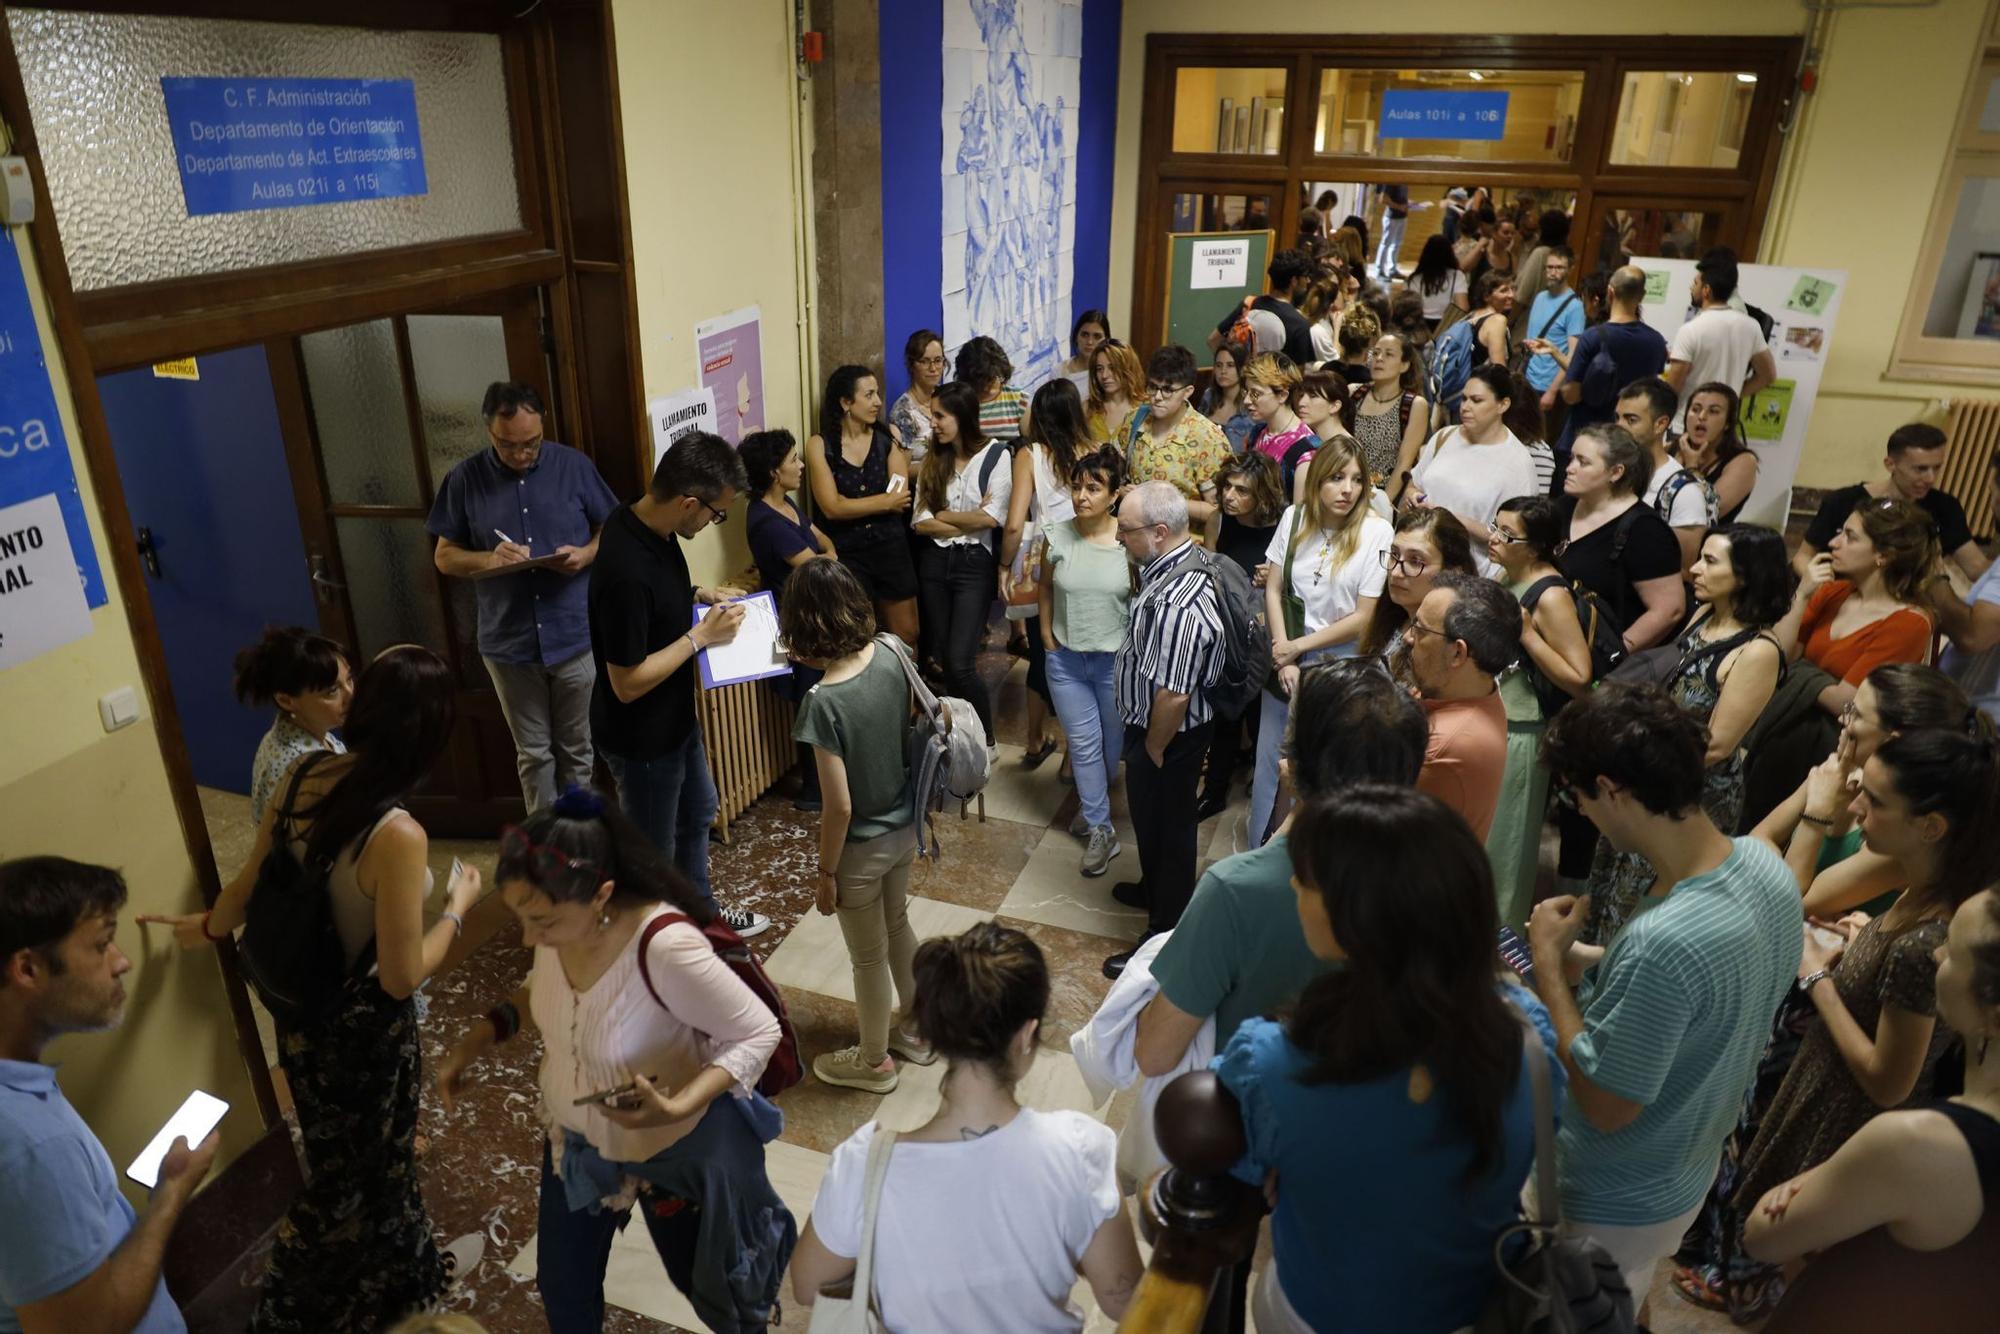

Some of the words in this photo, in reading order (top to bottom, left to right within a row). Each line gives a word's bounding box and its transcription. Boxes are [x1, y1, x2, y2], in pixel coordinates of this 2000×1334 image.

[224, 88, 241, 107] C.
[246, 88, 261, 106] F.
[267, 87, 371, 106] Administración
[1387, 108, 1421, 120] Aulas
[1458, 112, 1466, 121] a
[191, 119, 303, 143] Departamento
[307, 118, 325, 136] de
[329, 116, 404, 136] Orientación
[185, 151, 284, 175] Departamento
[287, 150, 304, 167] de
[307, 147, 329, 165] Act.
[333, 145, 416, 164] Extraescolares
[252, 180, 294, 200] Aulas
[298, 178, 328, 196] 021i
[336, 178, 345, 192] a
[1202, 248, 1242, 256] LLAMAMIENTO
[1219, 269, 1223, 280] 1
[662, 402, 707, 431] LLAMAMIENTO
[0, 525, 43, 561] NTO
